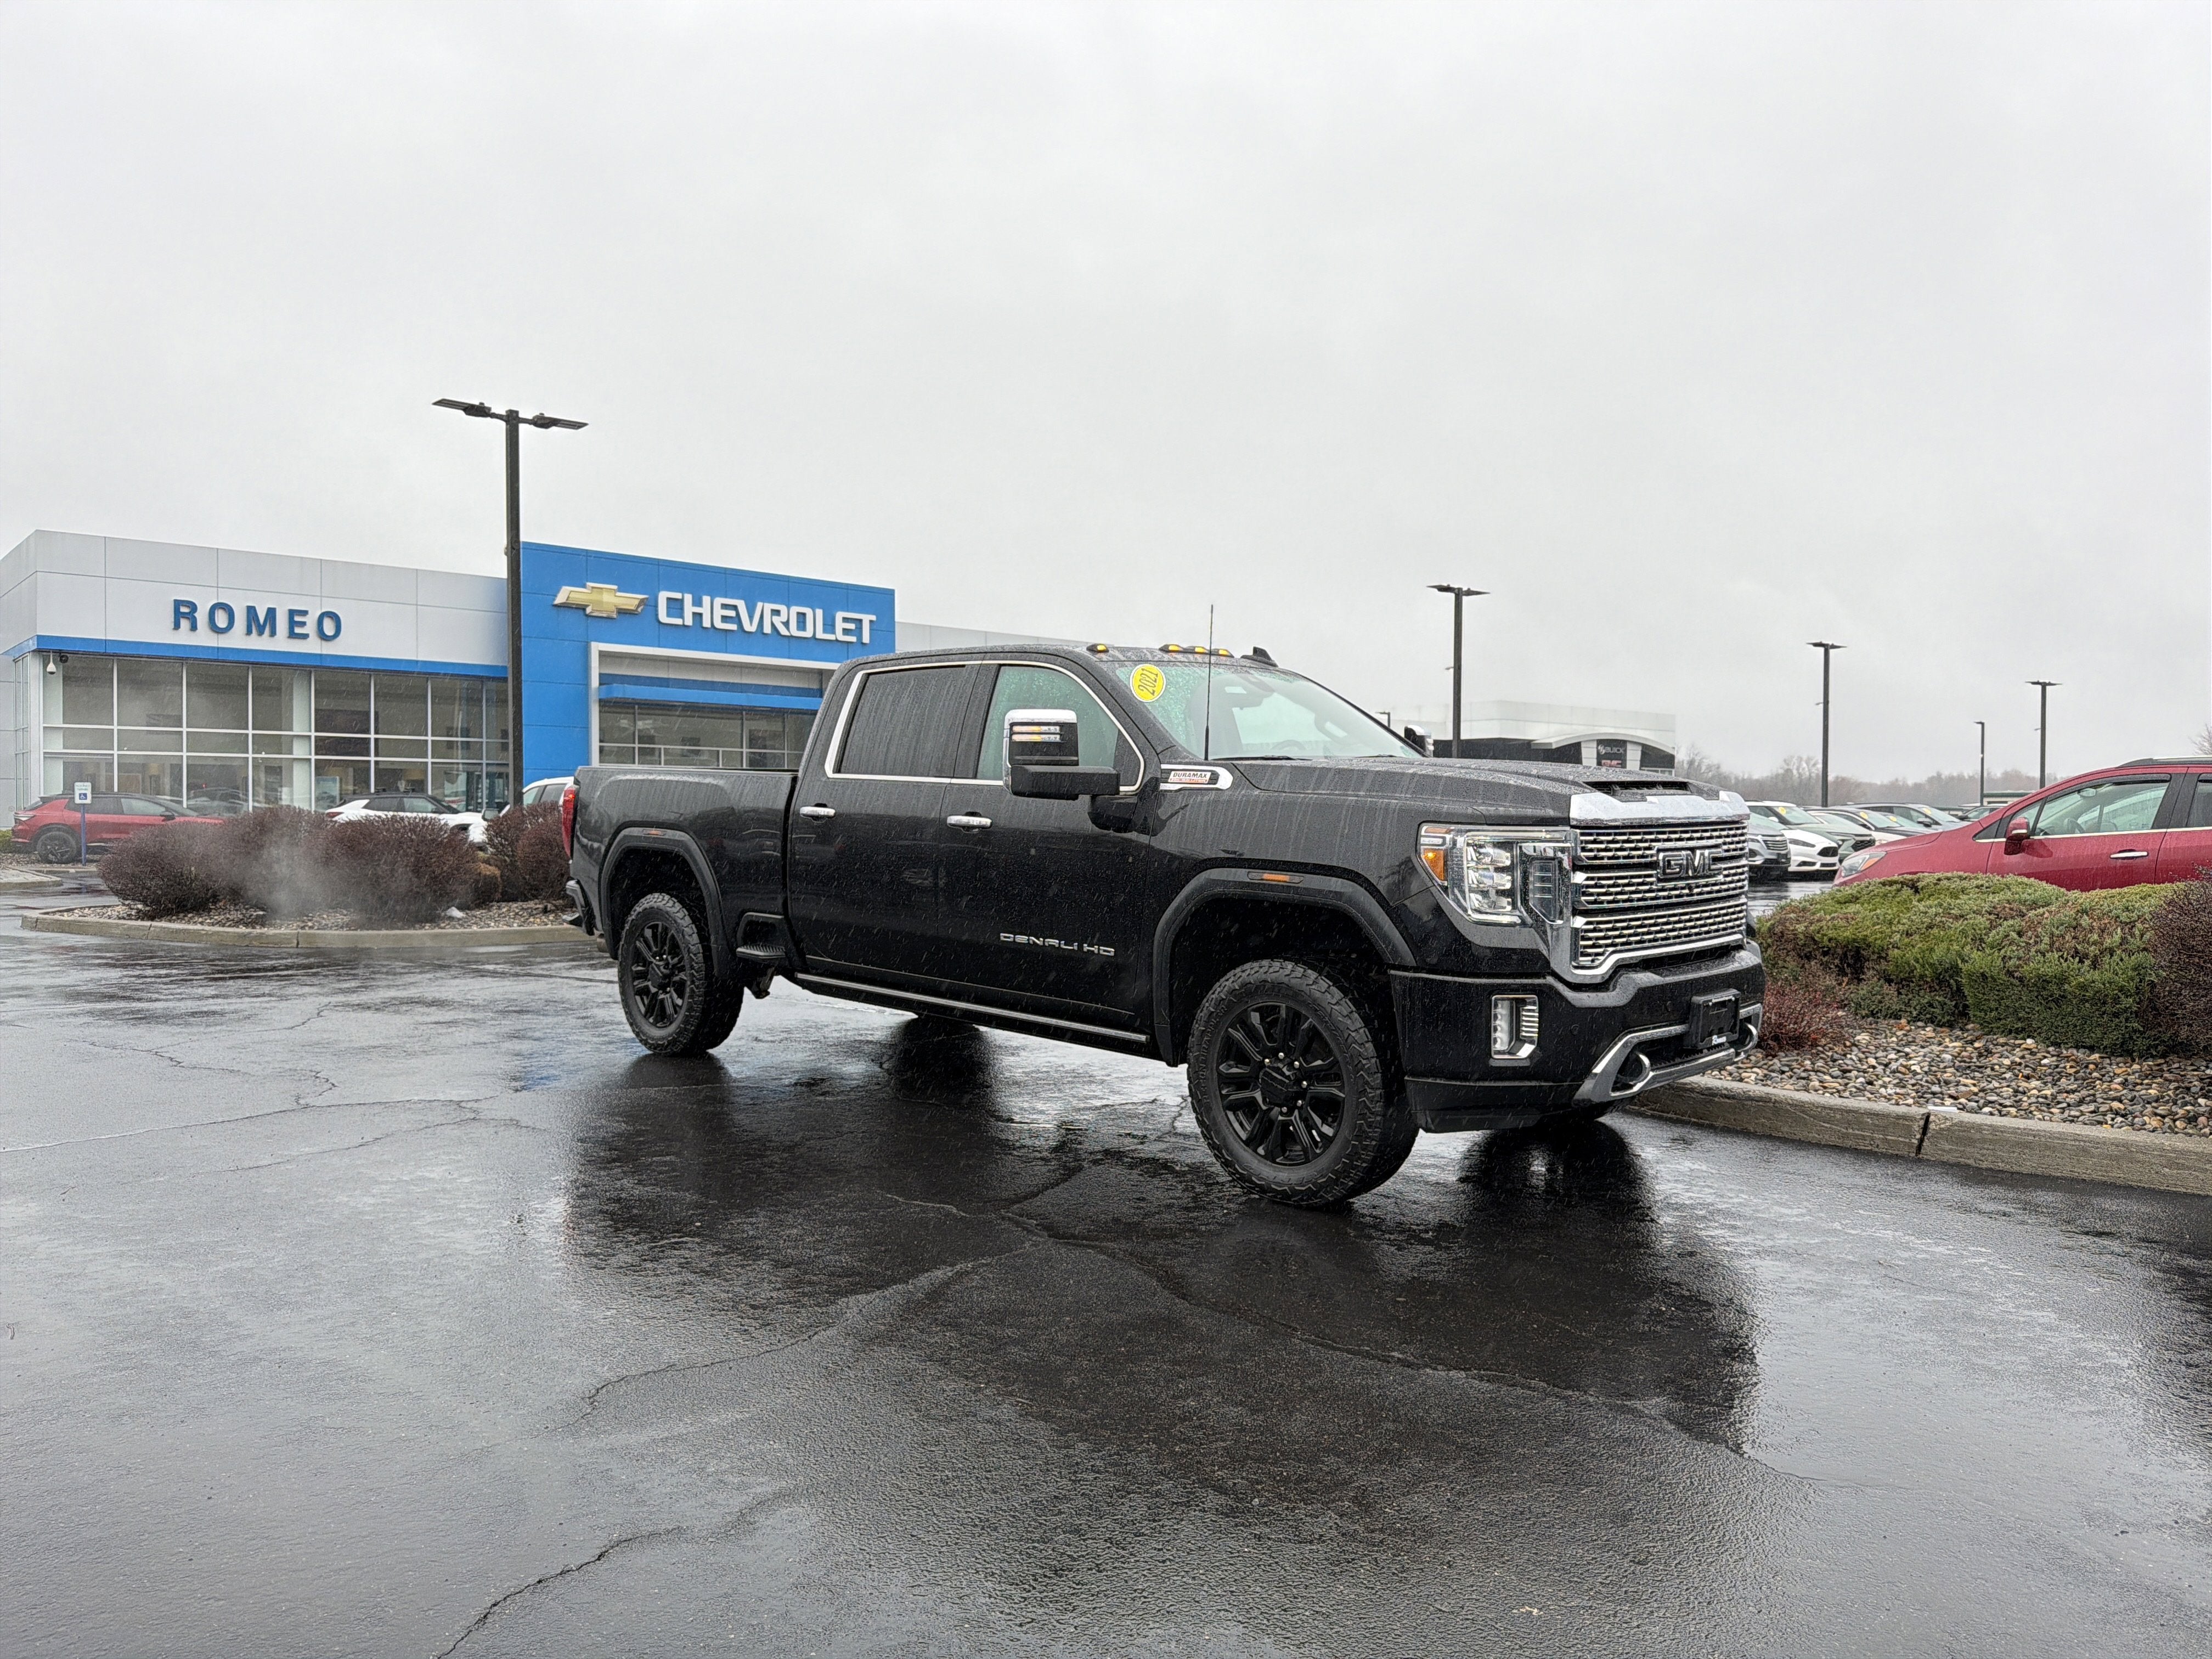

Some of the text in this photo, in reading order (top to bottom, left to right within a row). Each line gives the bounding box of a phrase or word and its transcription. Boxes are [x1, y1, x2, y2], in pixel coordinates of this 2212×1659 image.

[172, 599, 342, 641] ROMEO
[658, 590, 877, 644] CHEVROLET
[1138, 668, 1158, 697] 2021
[1658, 849, 1723, 878] GMC
[1000, 933, 1115, 957] DENALI HD
